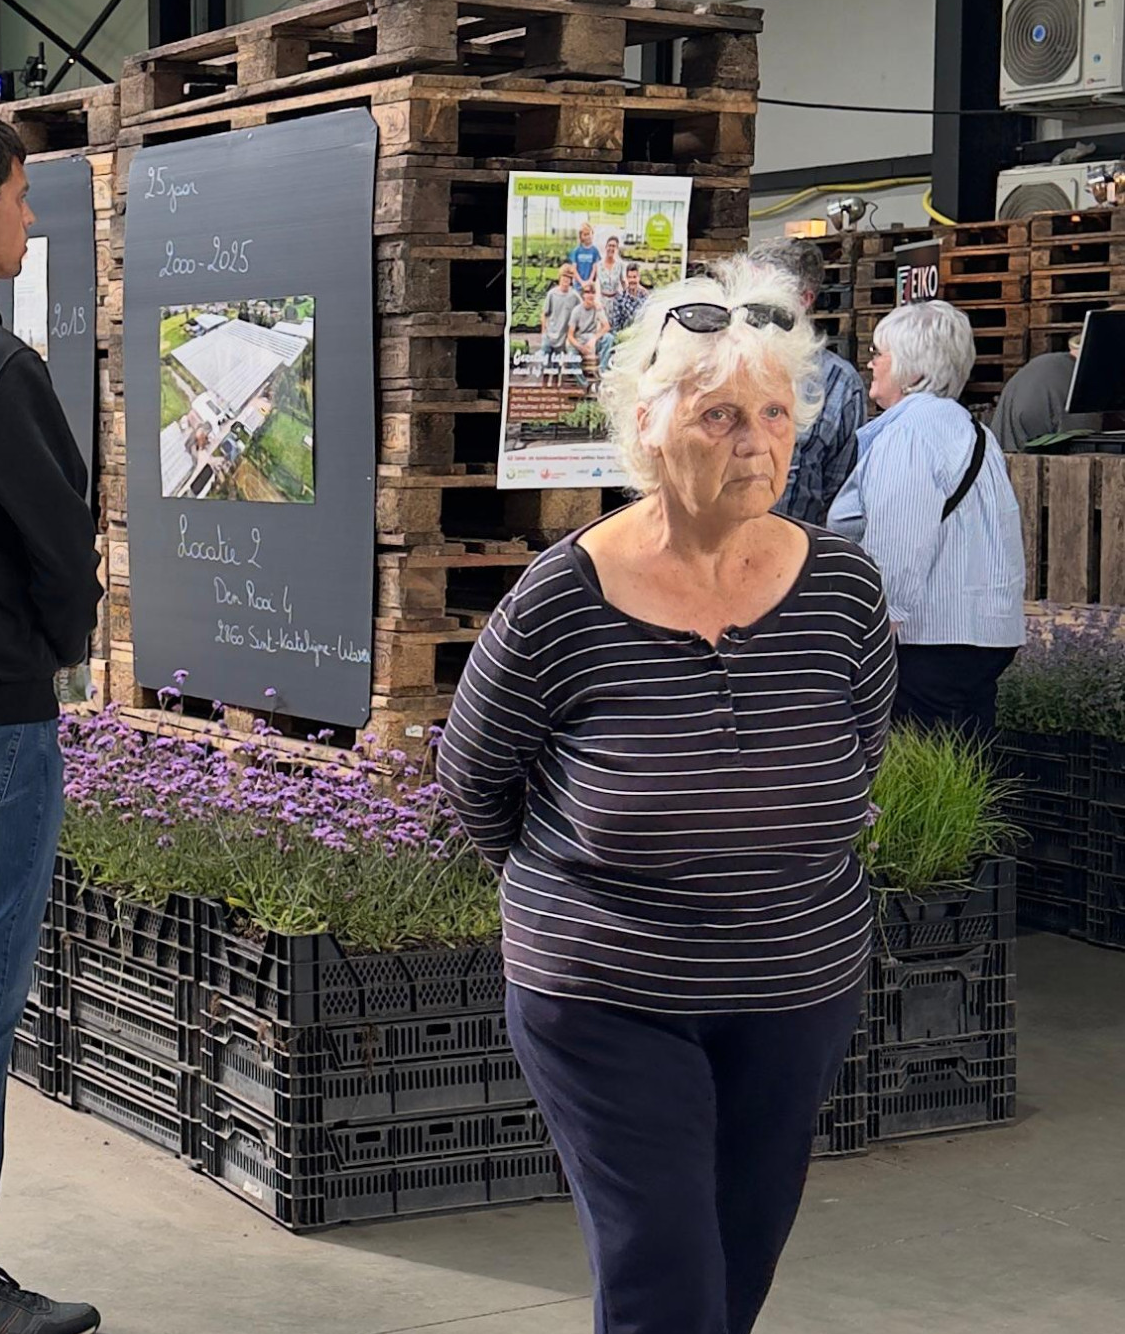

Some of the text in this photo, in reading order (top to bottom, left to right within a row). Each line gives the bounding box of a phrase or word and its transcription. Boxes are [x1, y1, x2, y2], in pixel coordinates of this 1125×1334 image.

[144, 166, 199, 214] 25 jaar
[535, 183, 550, 192] VAN
[551, 184, 561, 192] DE
[563, 183, 630, 198] LANDBOUW
[178, 514, 241, 566] Locatie
[247, 527, 262, 569] 2
[214, 576, 242, 605] Den
[282, 585, 292, 624] 4
